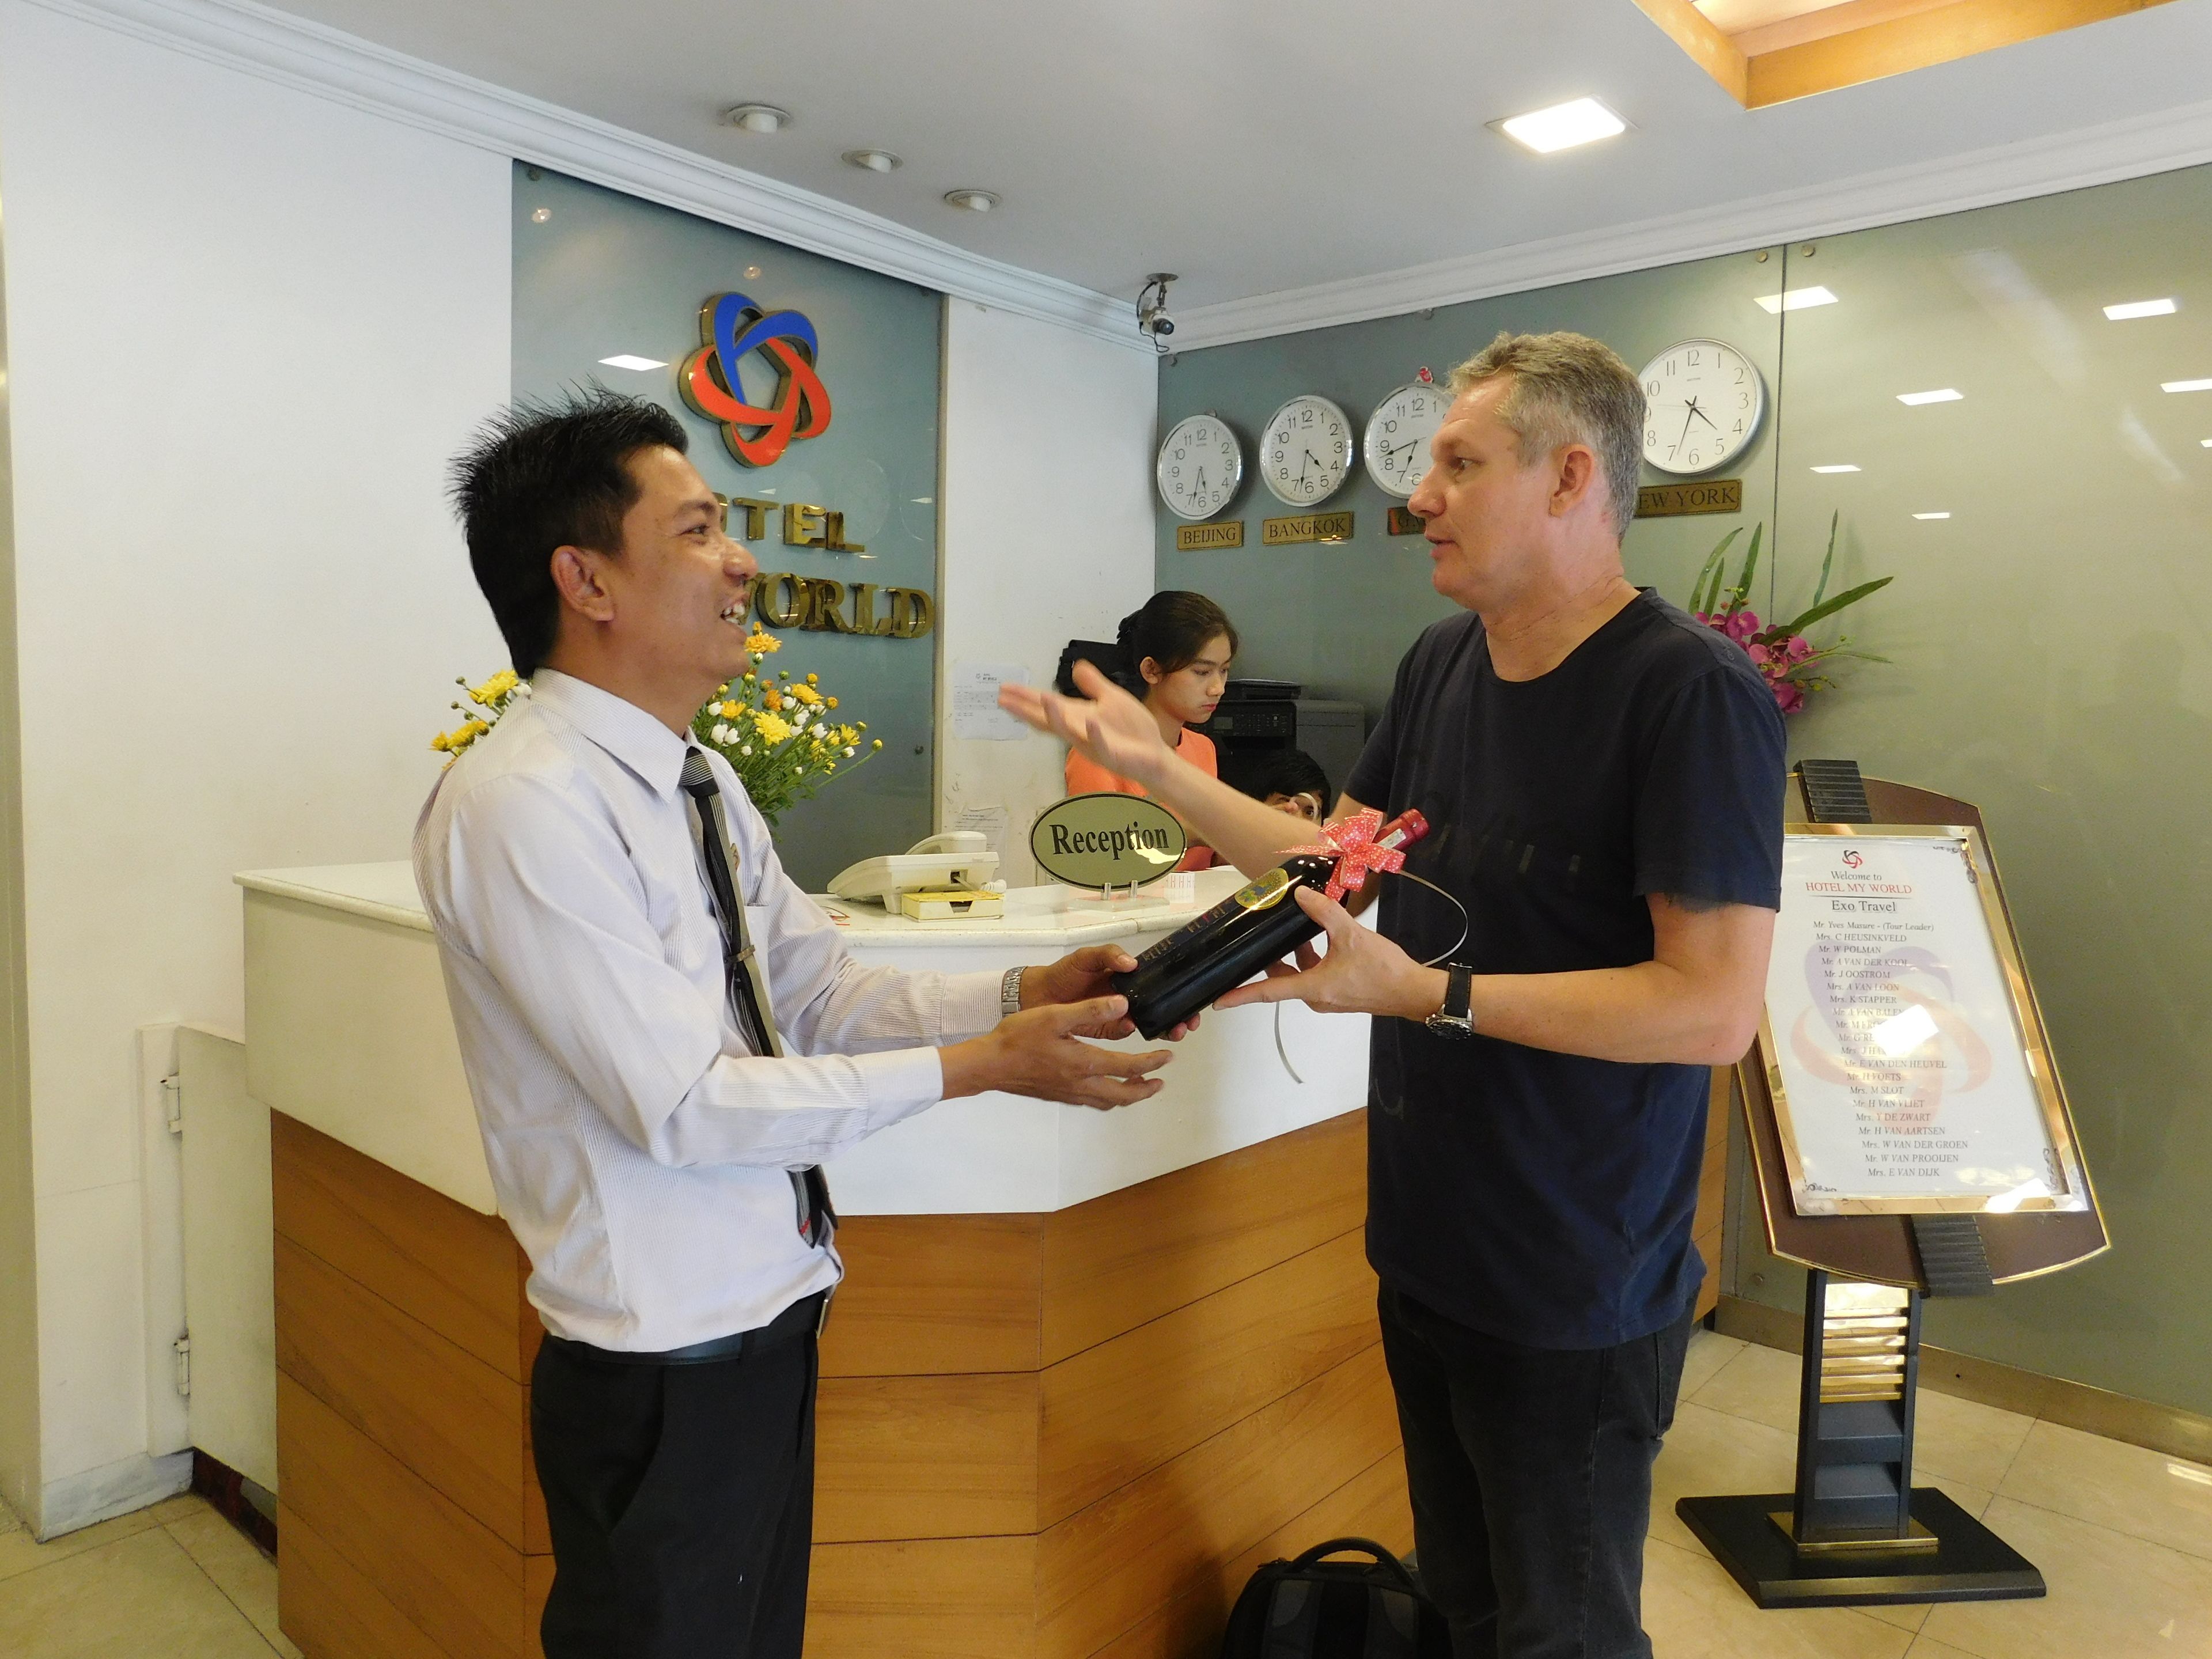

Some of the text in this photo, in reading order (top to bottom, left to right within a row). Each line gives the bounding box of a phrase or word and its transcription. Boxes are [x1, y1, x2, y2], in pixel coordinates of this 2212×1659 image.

[1687, 350, 1699, 366] 12
[1718, 353, 1721, 369] 1
[1666, 359, 1675, 376] 11
[1734, 368, 1744, 385] 2
[1647, 380, 1660, 397] 10
[1412, 398, 1425, 411] 12
[1738, 392, 1749, 409] 3
[1396, 405, 1406, 417] 11
[1433, 401, 1436, 413] 1
[1301, 410, 1313, 422] 12
[1320, 412, 1324, 423] 1
[1288, 416, 1296, 429] 11
[1384, 420, 1397, 433] 10
[1732, 418, 1743, 434] 4
[1196, 429, 1207, 441] 12
[1329, 423, 1338, 436] 2
[1184, 434, 1192, 445] 11
[1214, 431, 1217, 441] 1
[1278, 431, 1289, 444] 10
[1647, 430, 1656, 446] 8
[1221, 442, 1229, 454] 2
[1334, 441, 1343, 454] 3
[1380, 440, 1390, 452] 9
[1714, 438, 1725, 455] 5
[1174, 448, 1185, 460] 10
[1275, 450, 1284, 463] 9
[1667, 445, 1676, 461] 7
[1689, 448, 1699, 465] 6
[1225, 459, 1233, 471] 3
[1330, 460, 1339, 471] 4
[1385, 458, 1394, 471] 8
[1171, 466, 1180, 478] 9
[1280, 468, 1289, 480] 8
[1397, 471, 1406, 483] 7
[1221, 477, 1229, 488] 4
[1291, 479, 1299, 491] 7
[1320, 475, 1329, 487] 5
[1176, 483, 1184, 494] 8
[1305, 481, 1314, 494] 6
[1186, 494, 1193, 505] 7
[1198, 496, 1206, 507] 6
[1212, 491, 1220, 502] 5
[1638, 487, 1736, 509] EW YORK
[718, 492, 865, 553] TEL
[1268, 518, 1346, 539] BANGKOK
[1184, 527, 1236, 544] BEIJING
[1049, 821, 1169, 860] Reception
[1831, 870, 1870, 881] Welcome
[1805, 882, 1912, 893] HOTEL MY WORLD
[1832, 900, 1896, 912] Exo Travel
[1828, 921, 1843, 929] Yves
[1883, 922, 1903, 931] (Tour
[1905, 923, 1934, 931] Leader)
[1844, 934, 1907, 942] HEUSINKVELD
[1855, 983, 1872, 991] VAN
[1885, 1113, 1897, 1122] DE
[1900, 1113, 1931, 1122] ZWART
[1874, 1127, 1881, 1135] H
[1885, 1127, 1901, 1135] VAN
[1903, 1127, 1945, 1135] AARTSEN
[1862, 1141, 1968, 1149] Mrs. W VAN DER GROEN
[1865, 1154, 1878, 1162] Mr.
[1881, 1154, 1889, 1162] W
[1892, 1154, 1910, 1162] VAN
[1868, 1168, 1940, 1176] Mrs. E VAN DIJK
